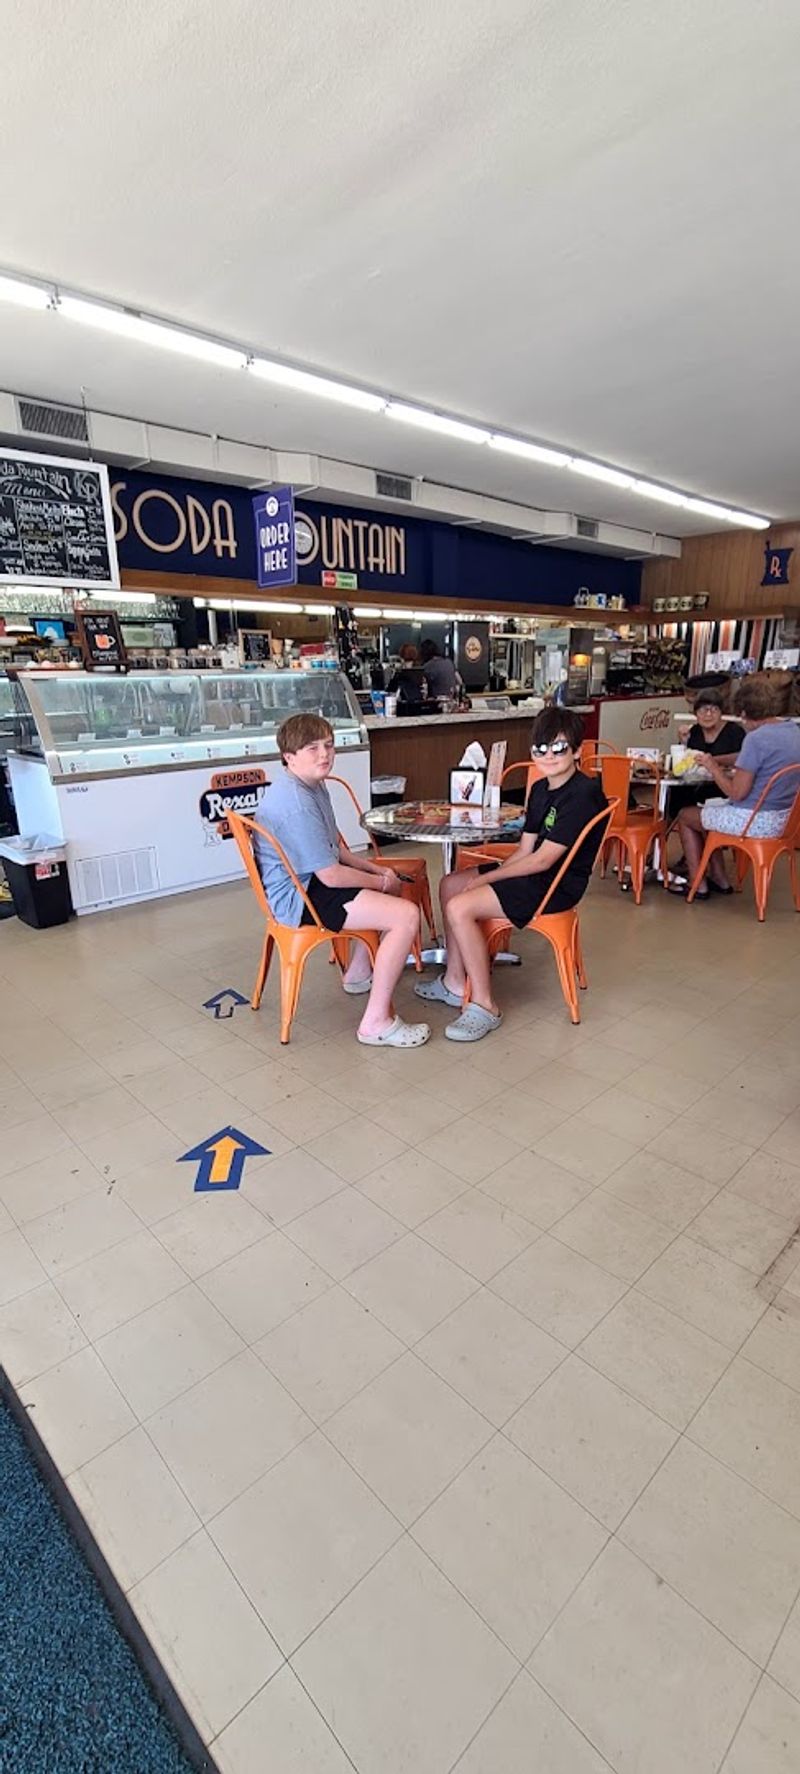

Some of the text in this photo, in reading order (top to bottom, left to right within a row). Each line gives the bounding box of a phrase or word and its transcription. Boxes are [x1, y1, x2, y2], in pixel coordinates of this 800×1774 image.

[4, 482, 45, 497] Menu
[111, 482, 405, 575] SODA OUNTAIN
[260, 522, 289, 549] ORDER
[264, 547, 288, 573] HERE
[215, 771, 261, 787] KEMPSON
[205, 786, 266, 820] Rexal
